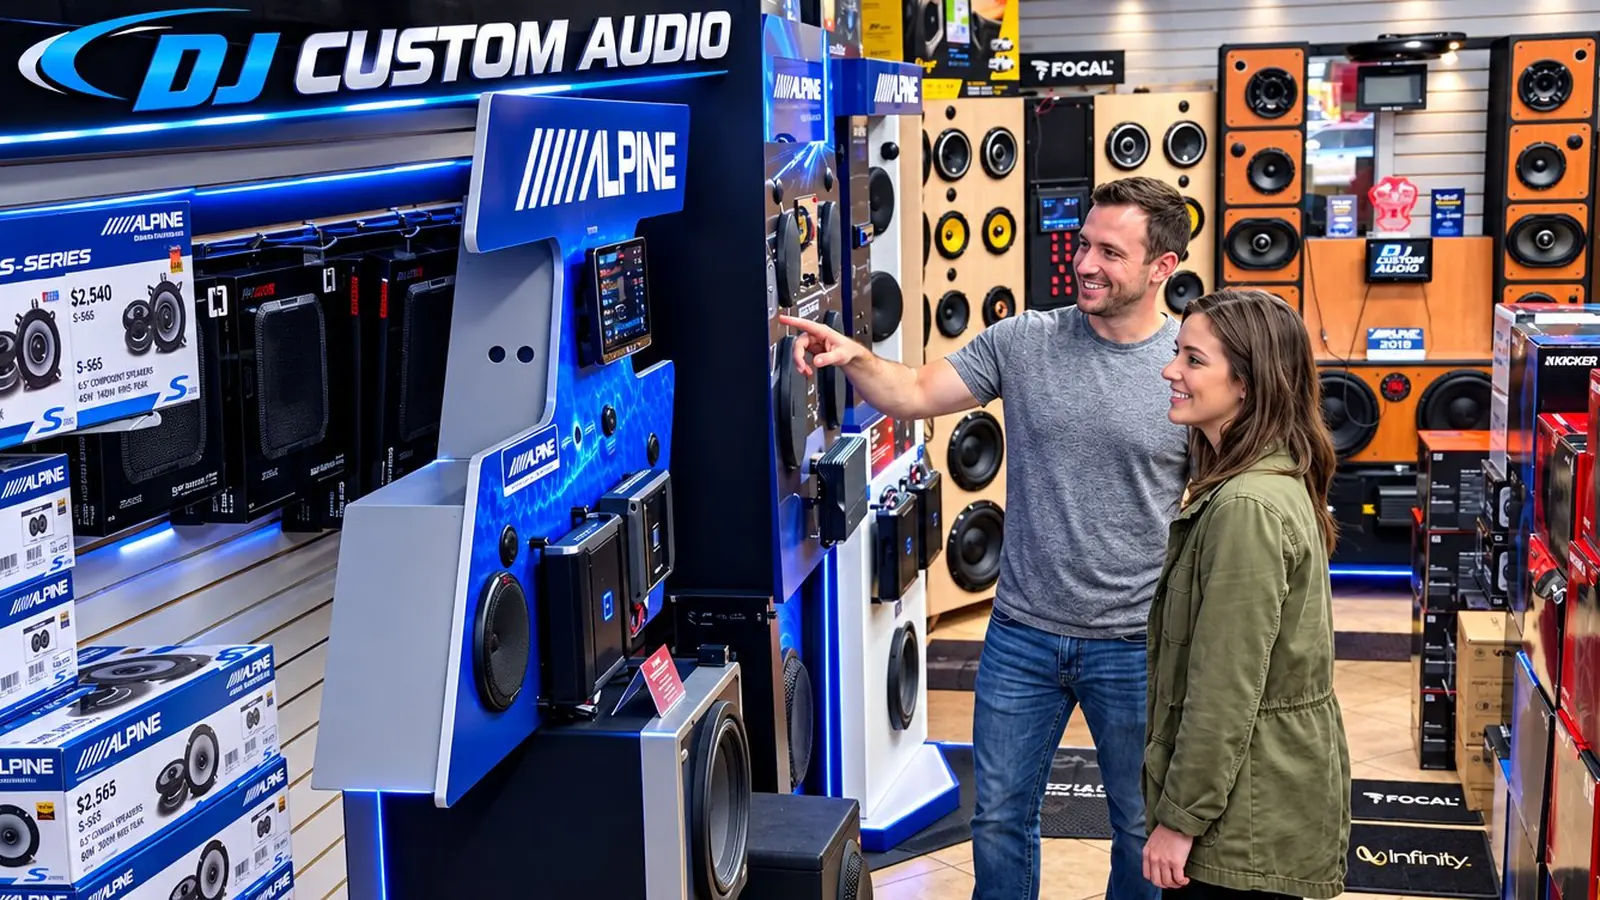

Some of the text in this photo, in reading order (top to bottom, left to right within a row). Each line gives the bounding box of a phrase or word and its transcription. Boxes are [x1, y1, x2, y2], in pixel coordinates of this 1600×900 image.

[133, 10, 732, 112] DJ CUSTOM AUDIO
[1051, 60, 1114, 77] FOCAL
[579, 129, 676, 201] ALPINE
[131, 211, 184, 233] ALPINE
[0, 249, 91, 276] S-SERIES
[1374, 263, 1419, 273] AUDIO
[1376, 255, 1425, 264] CUSTOM
[71, 284, 112, 307] $2,540
[1555, 356, 1598, 366] KICKER
[104, 712, 162, 758] ALPINE
[0, 758, 54, 775] LPINE
[76, 779, 116, 815] $2,565
[1386, 795, 1459, 806] FOCAL
